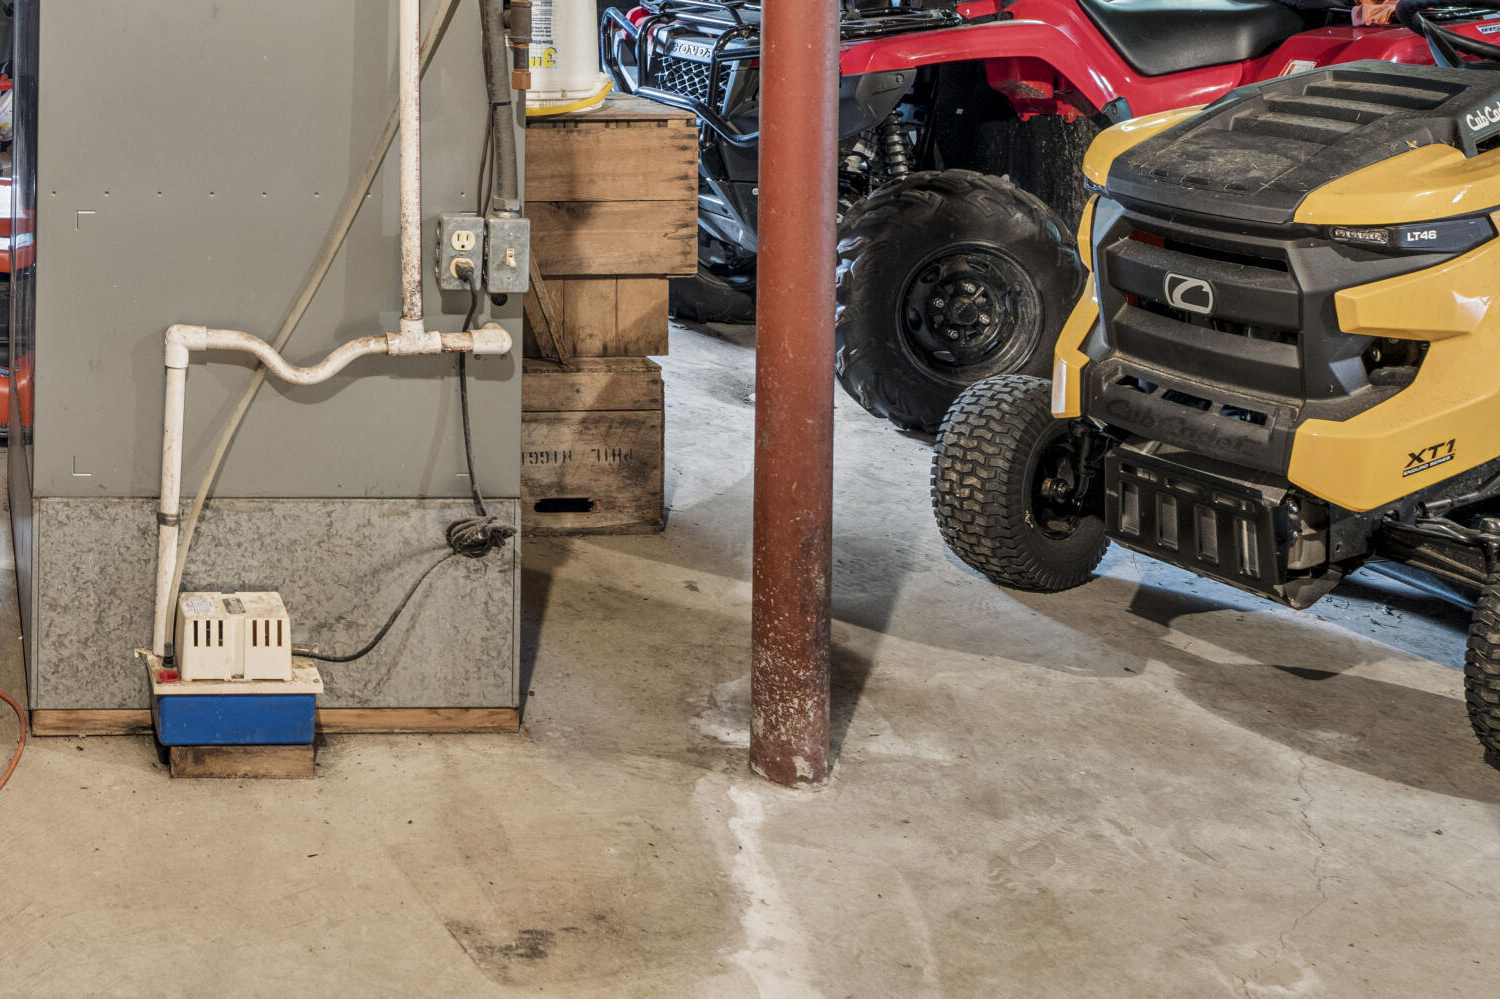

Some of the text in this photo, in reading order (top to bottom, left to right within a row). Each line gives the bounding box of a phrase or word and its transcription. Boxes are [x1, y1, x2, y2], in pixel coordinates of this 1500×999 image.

[674, 41, 712, 58] HONDA
[1465, 109, 1490, 131] Cub
[1406, 229, 1438, 242] LT46
[520, 447, 633, 466] PHIL HIGGI
[1403, 437, 1457, 469] XT1
